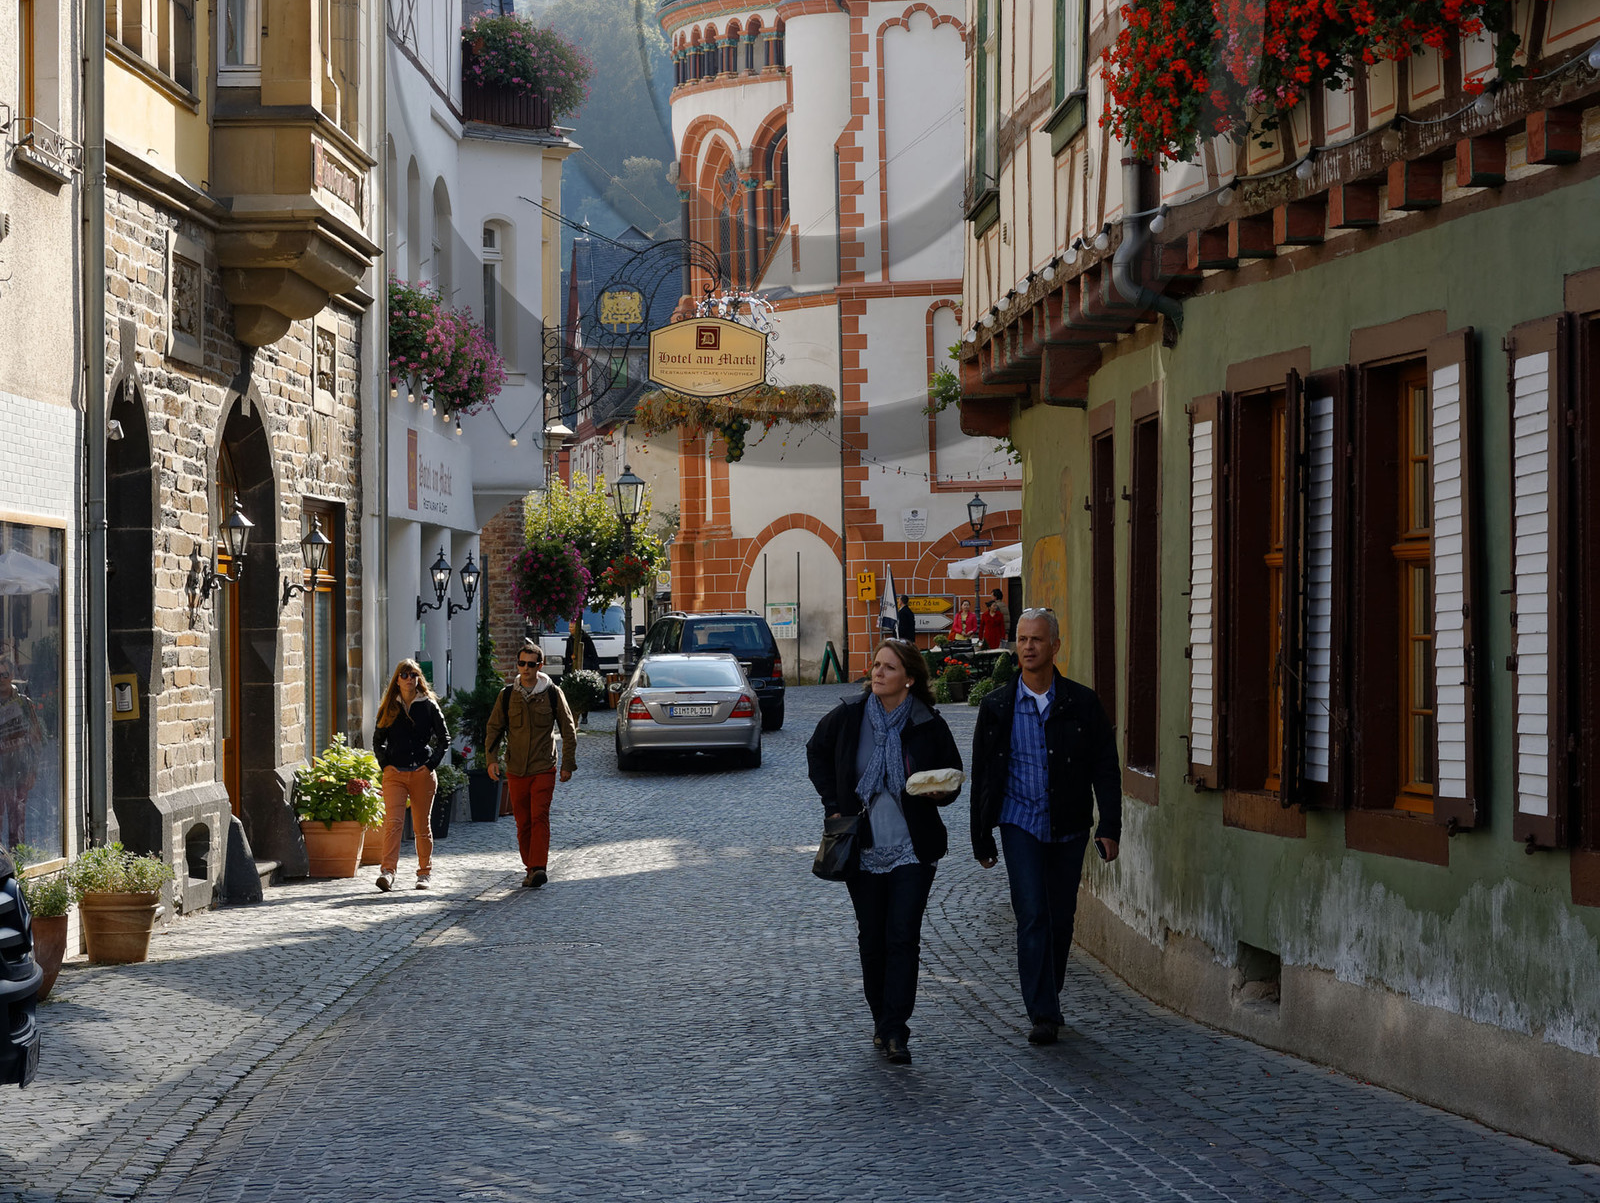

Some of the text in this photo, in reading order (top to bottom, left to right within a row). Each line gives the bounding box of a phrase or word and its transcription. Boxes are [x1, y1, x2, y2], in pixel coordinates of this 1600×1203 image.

[658, 351, 757, 366] Hotel am Markt
[860, 574, 872, 584] U1
[923, 599, 932, 607] 26
[700, 707, 711, 715] 211
